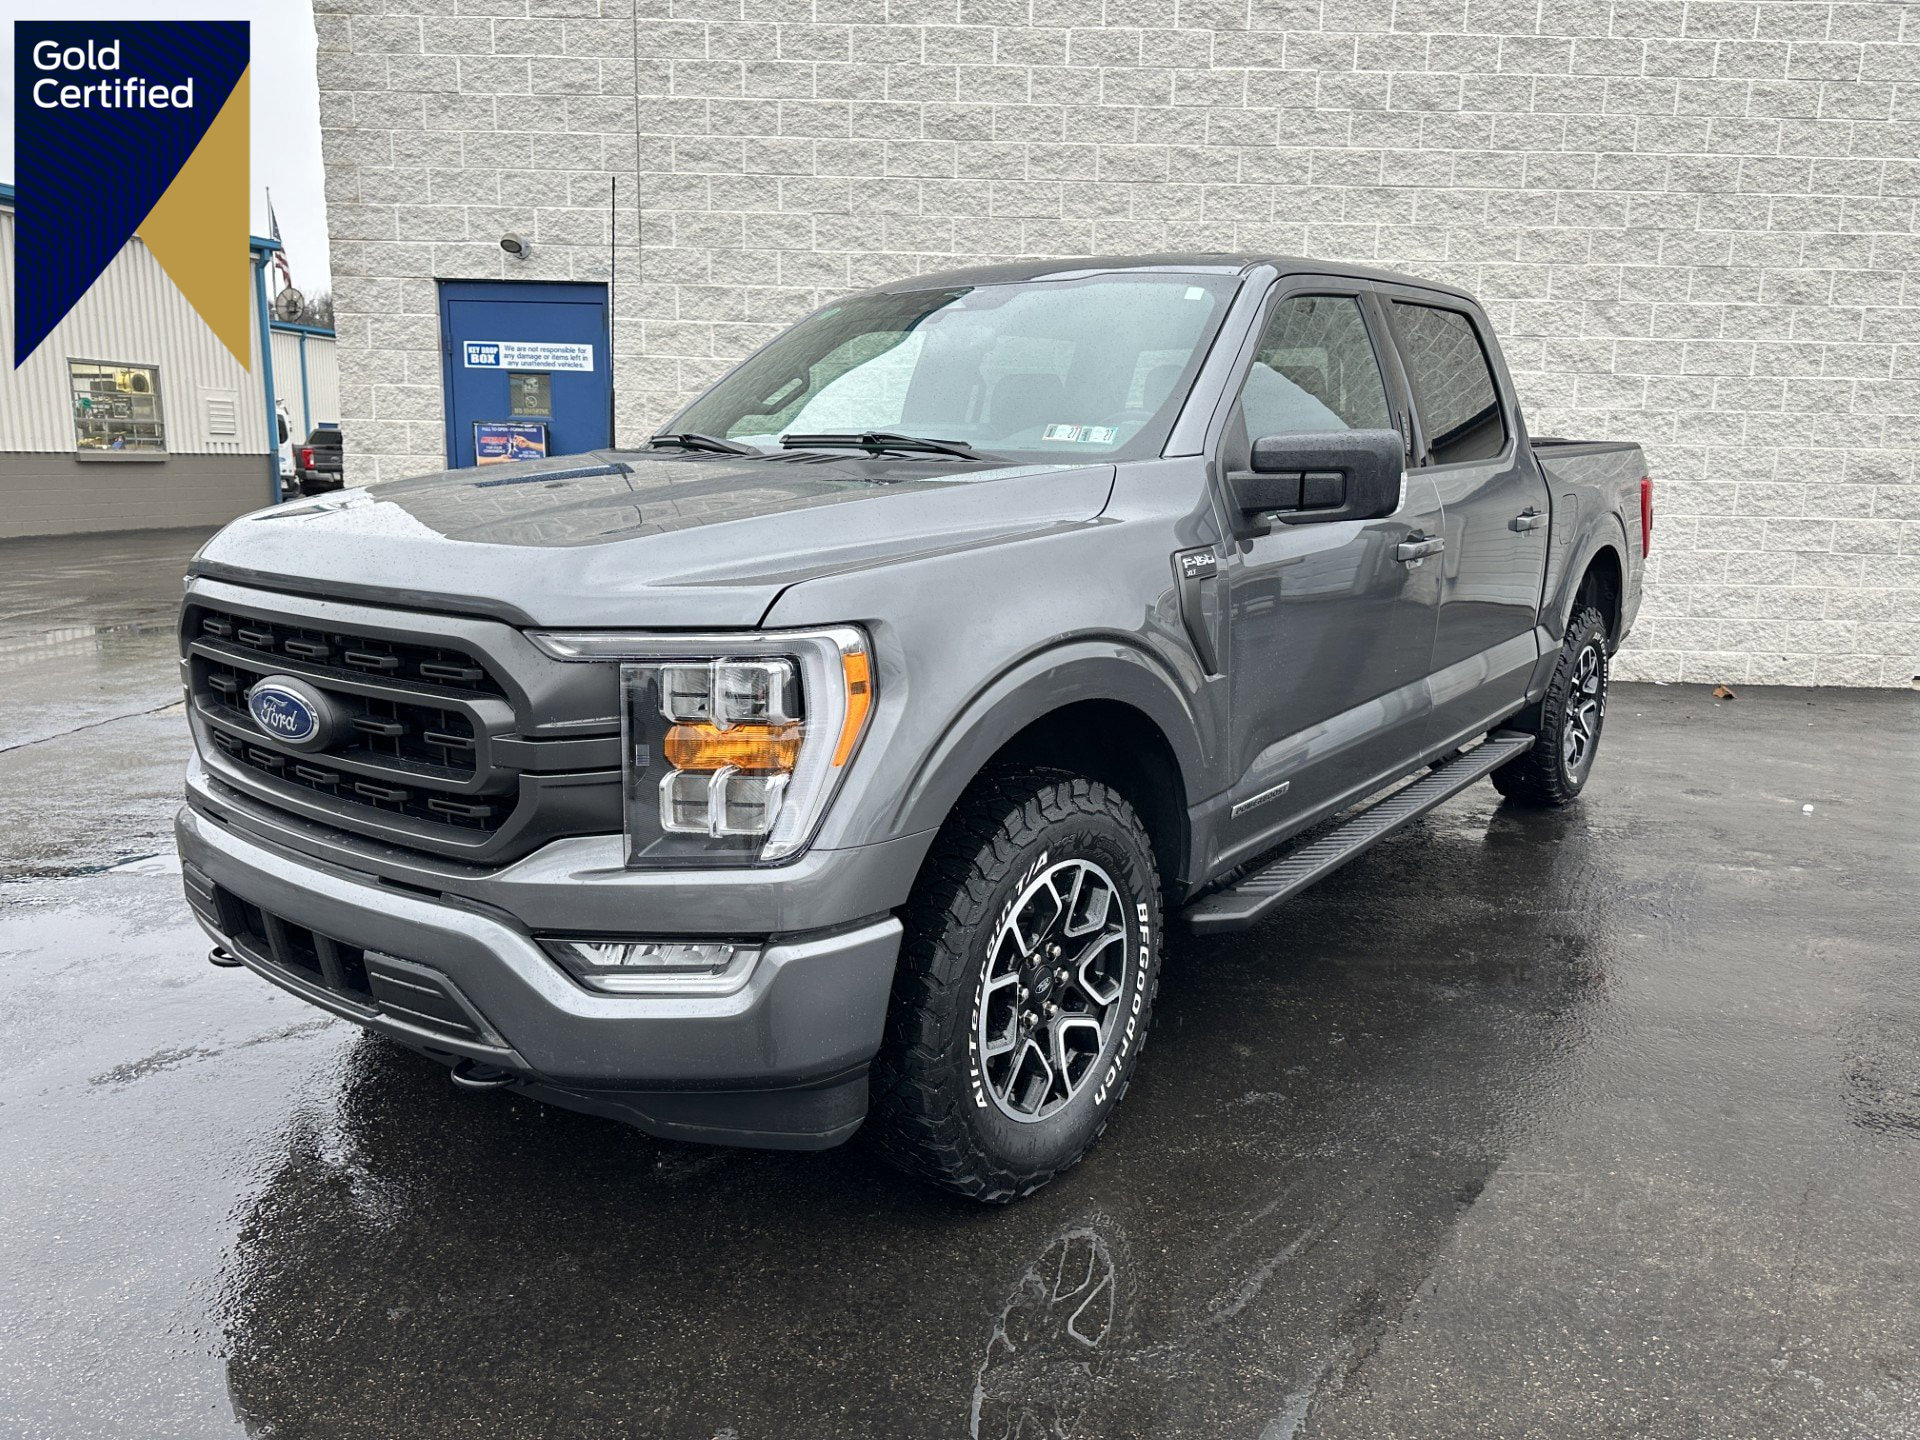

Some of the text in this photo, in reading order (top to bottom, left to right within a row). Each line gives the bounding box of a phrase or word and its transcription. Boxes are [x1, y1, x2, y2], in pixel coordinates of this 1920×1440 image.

[481, 346, 498, 354] DROP
[540, 346, 576, 355] responsible
[470, 353, 496, 364] BOX
[516, 353, 542, 361] damage
[1182, 554, 1216, 569] F-150
[260, 695, 299, 732] Ford
[968, 850, 1049, 1108] All-Terrain T/A
[1095, 902, 1149, 1106] BFGoodrich
